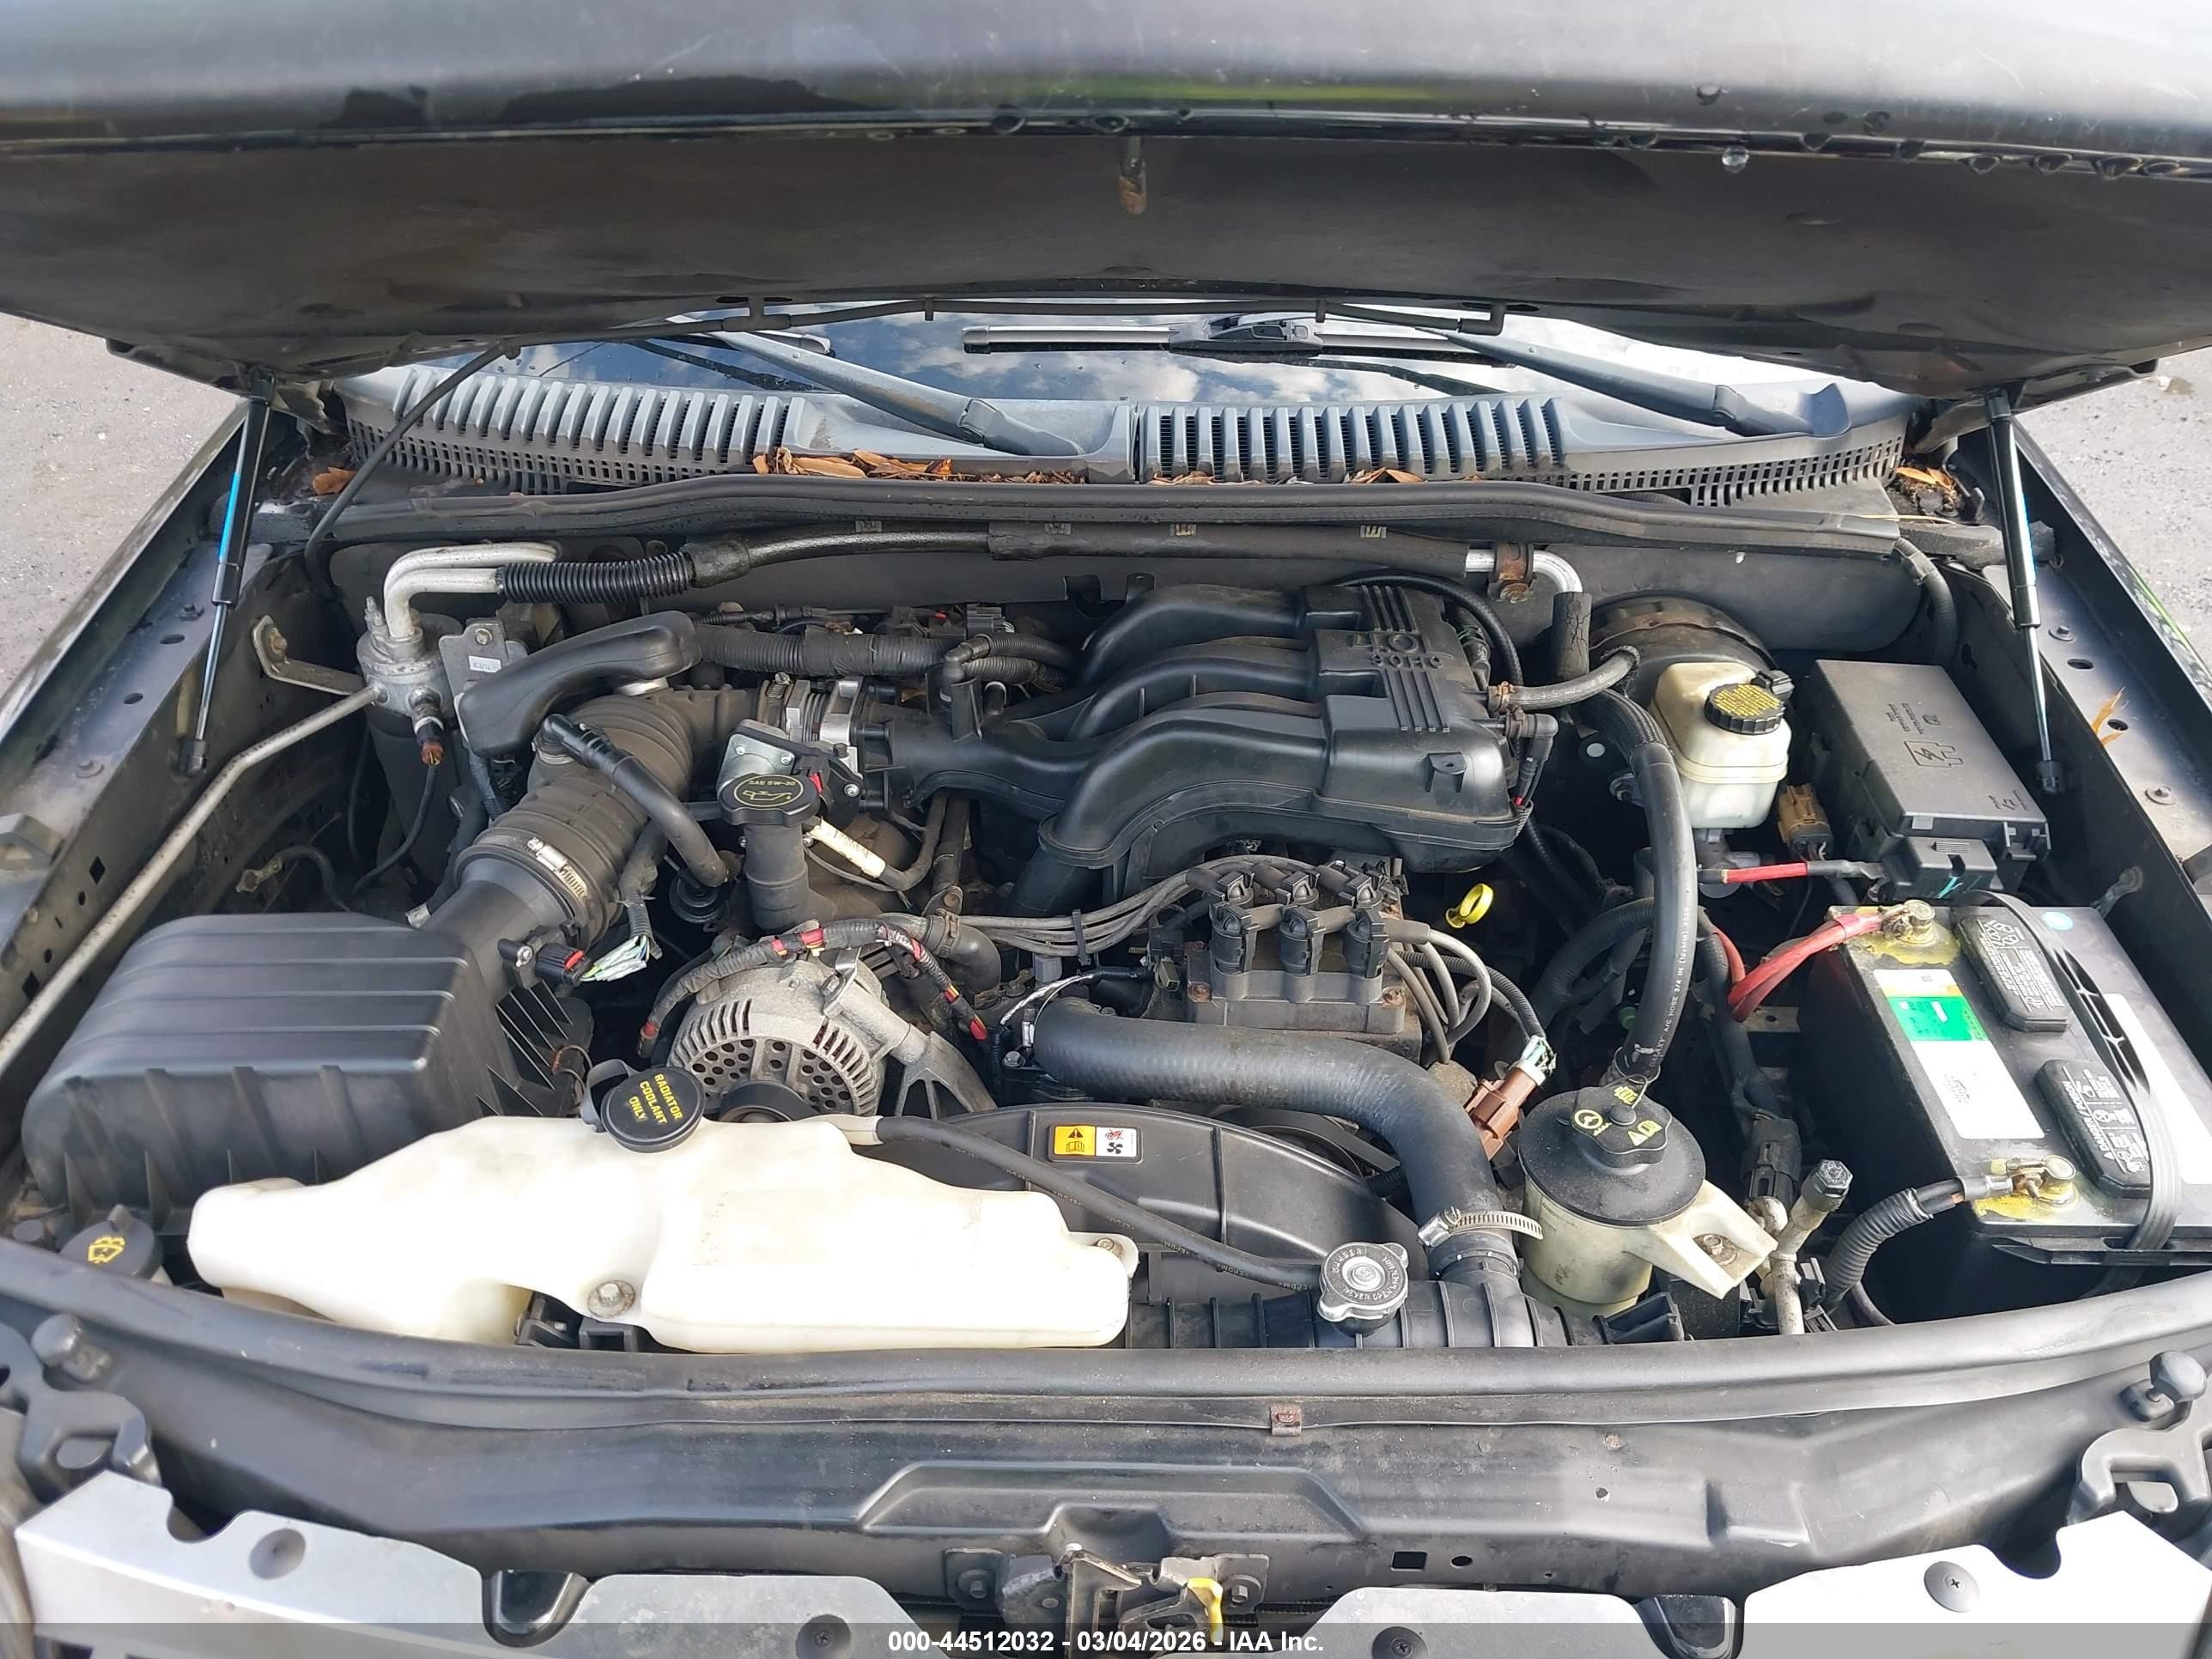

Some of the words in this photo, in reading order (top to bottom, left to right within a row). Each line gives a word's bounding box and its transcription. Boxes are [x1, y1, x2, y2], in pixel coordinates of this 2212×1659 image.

[1370, 650, 1443, 668] SOHC
[1668, 995, 1678, 1017] HOSE
[1674, 979, 1682, 993] 3/4
[629, 1096, 647, 1121] ONLY
[639, 1080, 667, 1124] COOLANT
[653, 1073, 684, 1120] RADIATOR
[2061, 1080, 2087, 1110] POISON
[2083, 1117, 2110, 1152] DANGER
